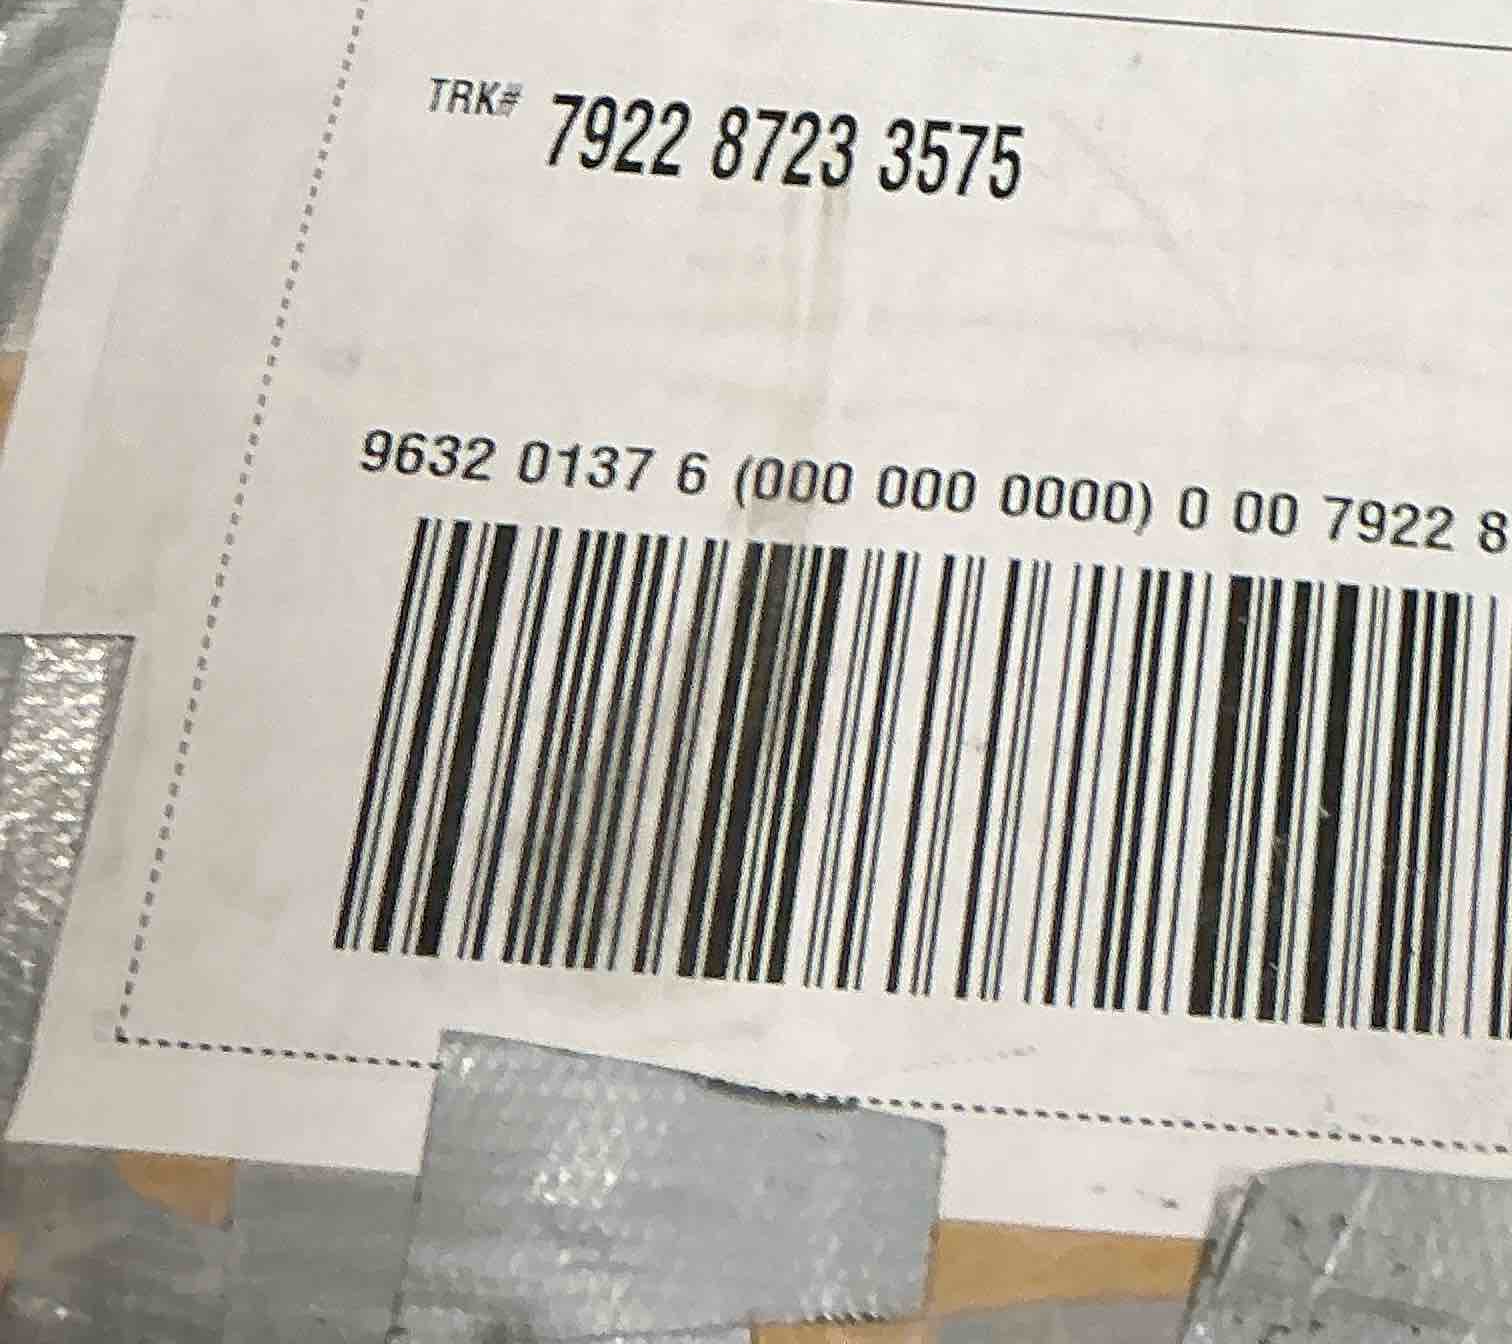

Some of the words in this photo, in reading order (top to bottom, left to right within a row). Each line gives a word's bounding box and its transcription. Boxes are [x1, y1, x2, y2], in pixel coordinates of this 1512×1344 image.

[427, 76, 523, 118] TRK#
[546, 92, 692, 176] 7922
[710, 106, 857, 188] 8723
[878, 118, 1024, 200] 3575
[361, 428, 497, 482] 9632
[518, 440, 655, 493] 0137
[675, 452, 709, 495] 6
[735, 454, 853, 508] (000
[877, 466, 976, 514] 000
[1000, 474, 1152, 535] 0000)
[1178, 486, 1209, 531] 0
[1233, 490, 1299, 537] 00
[1324, 496, 1455, 553] 7922
